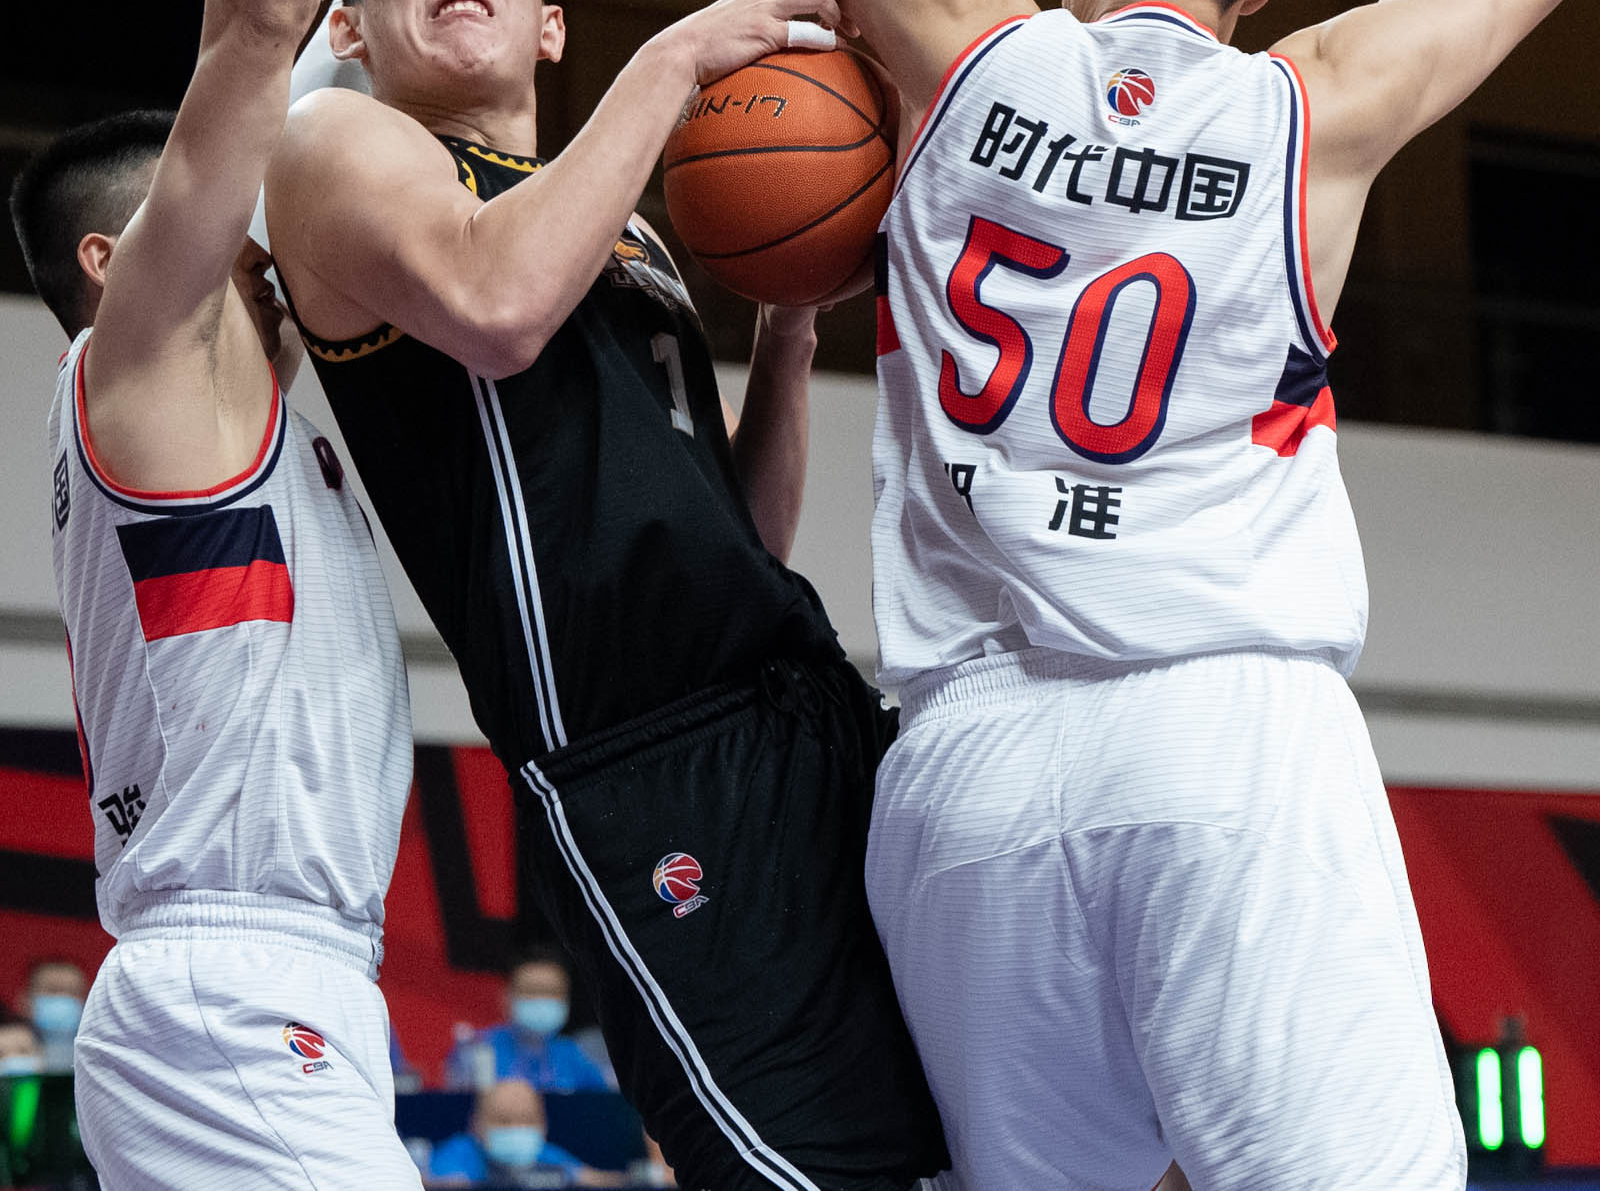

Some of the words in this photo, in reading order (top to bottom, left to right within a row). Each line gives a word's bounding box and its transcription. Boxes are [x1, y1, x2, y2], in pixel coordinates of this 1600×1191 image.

[969, 101, 1251, 222] 时代中国
[938, 214, 1197, 466] 50
[672, 895, 710, 919] CBA
[302, 1060, 335, 1074] CBA
